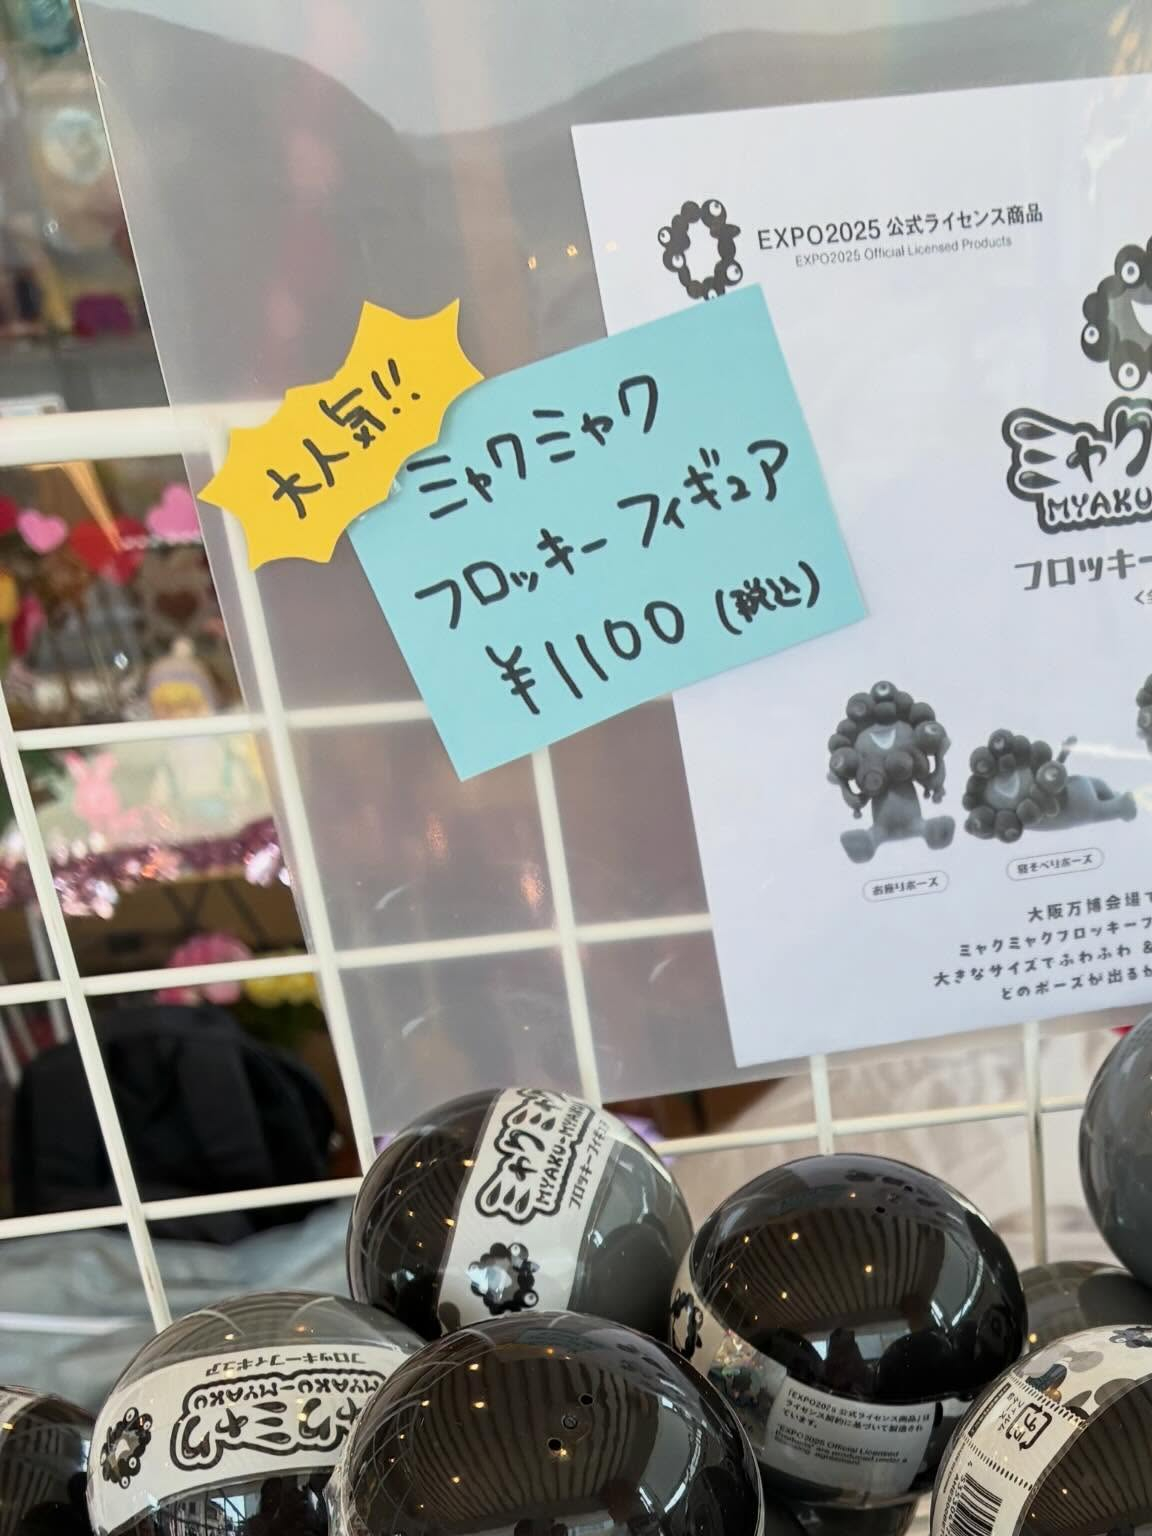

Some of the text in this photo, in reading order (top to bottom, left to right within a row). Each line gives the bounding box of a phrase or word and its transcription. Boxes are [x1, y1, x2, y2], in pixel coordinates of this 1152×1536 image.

[758, 203, 1044, 251] EXPO2025 公式ライセンス商品
[795, 235, 1013, 267] EXPO2025 Official Licensed Products
[271, 360, 421, 518] 大人気!!
[406, 375, 659, 520] ミャクミャク
[415, 440, 789, 629] フロッキーフィギュア
[487, 561, 821, 715] ¥1100 (税込)
